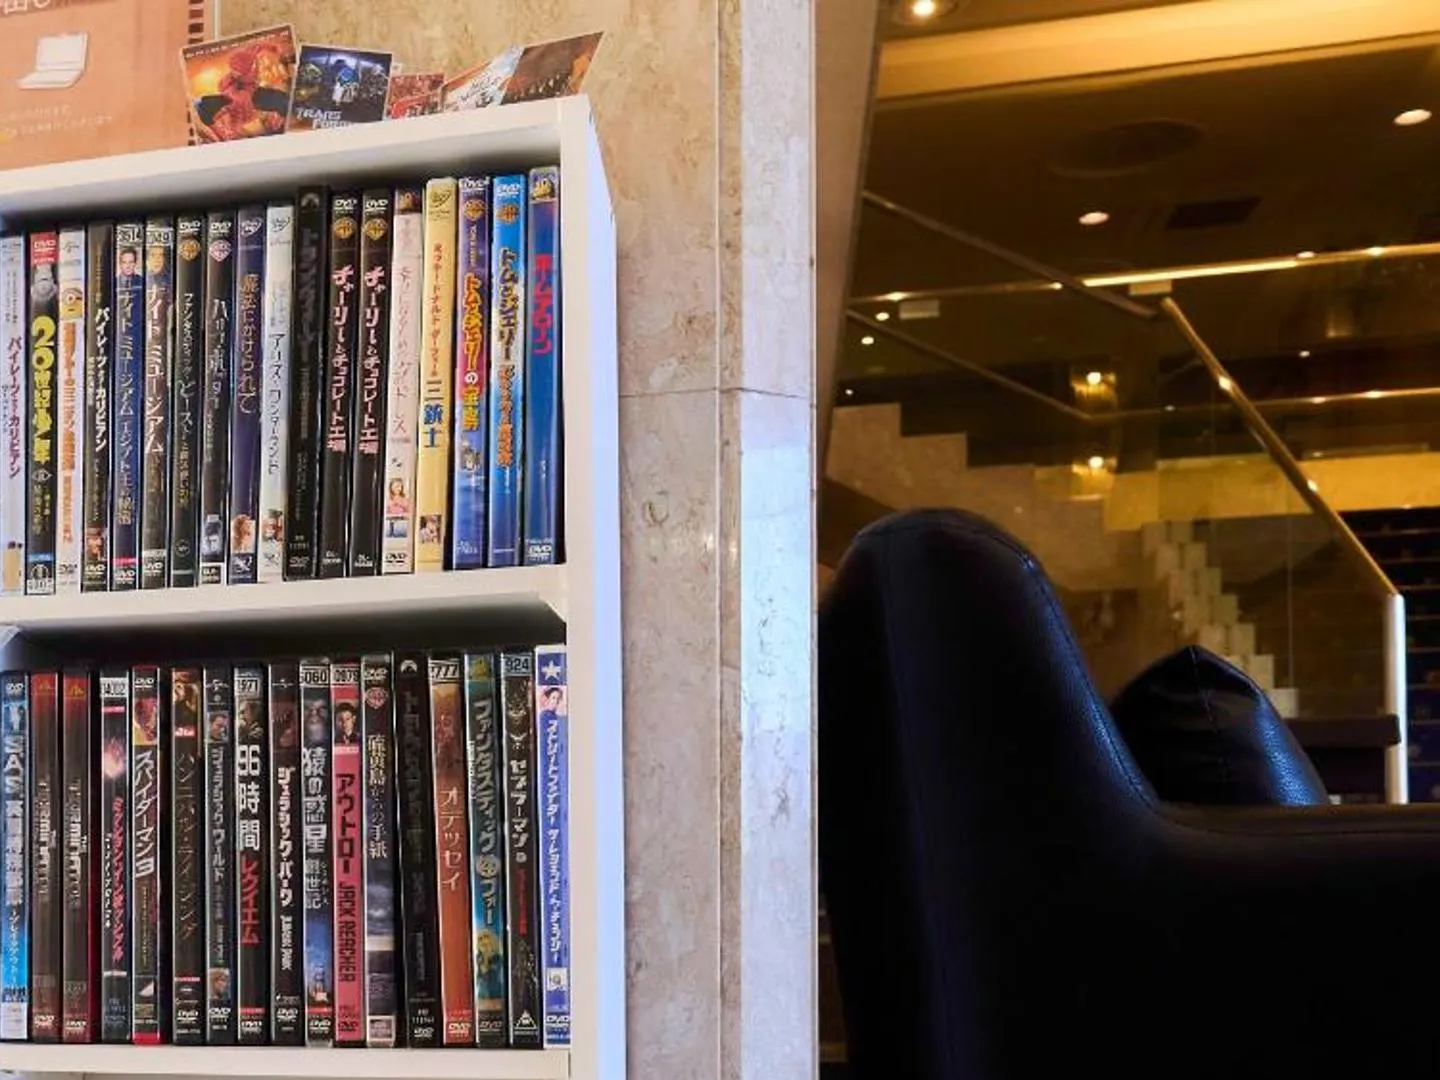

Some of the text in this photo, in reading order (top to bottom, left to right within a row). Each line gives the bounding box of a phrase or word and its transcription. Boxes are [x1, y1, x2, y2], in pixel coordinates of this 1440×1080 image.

[327, 264, 354, 452] チャーリーとチョコレート工場
[360, 266, 386, 454] チャーリーとチョコレート工場
[175, 753, 196, 941] ハンニバル・ライジング
[237, 744, 260, 945] 96時間 レクイエム
[302, 746, 327, 853] 猿の惑星
[336, 773, 356, 874] アウトロー
[367, 734, 388, 858] 硫黄島からの手紙
[338, 882, 356, 983] JACK REACHER
